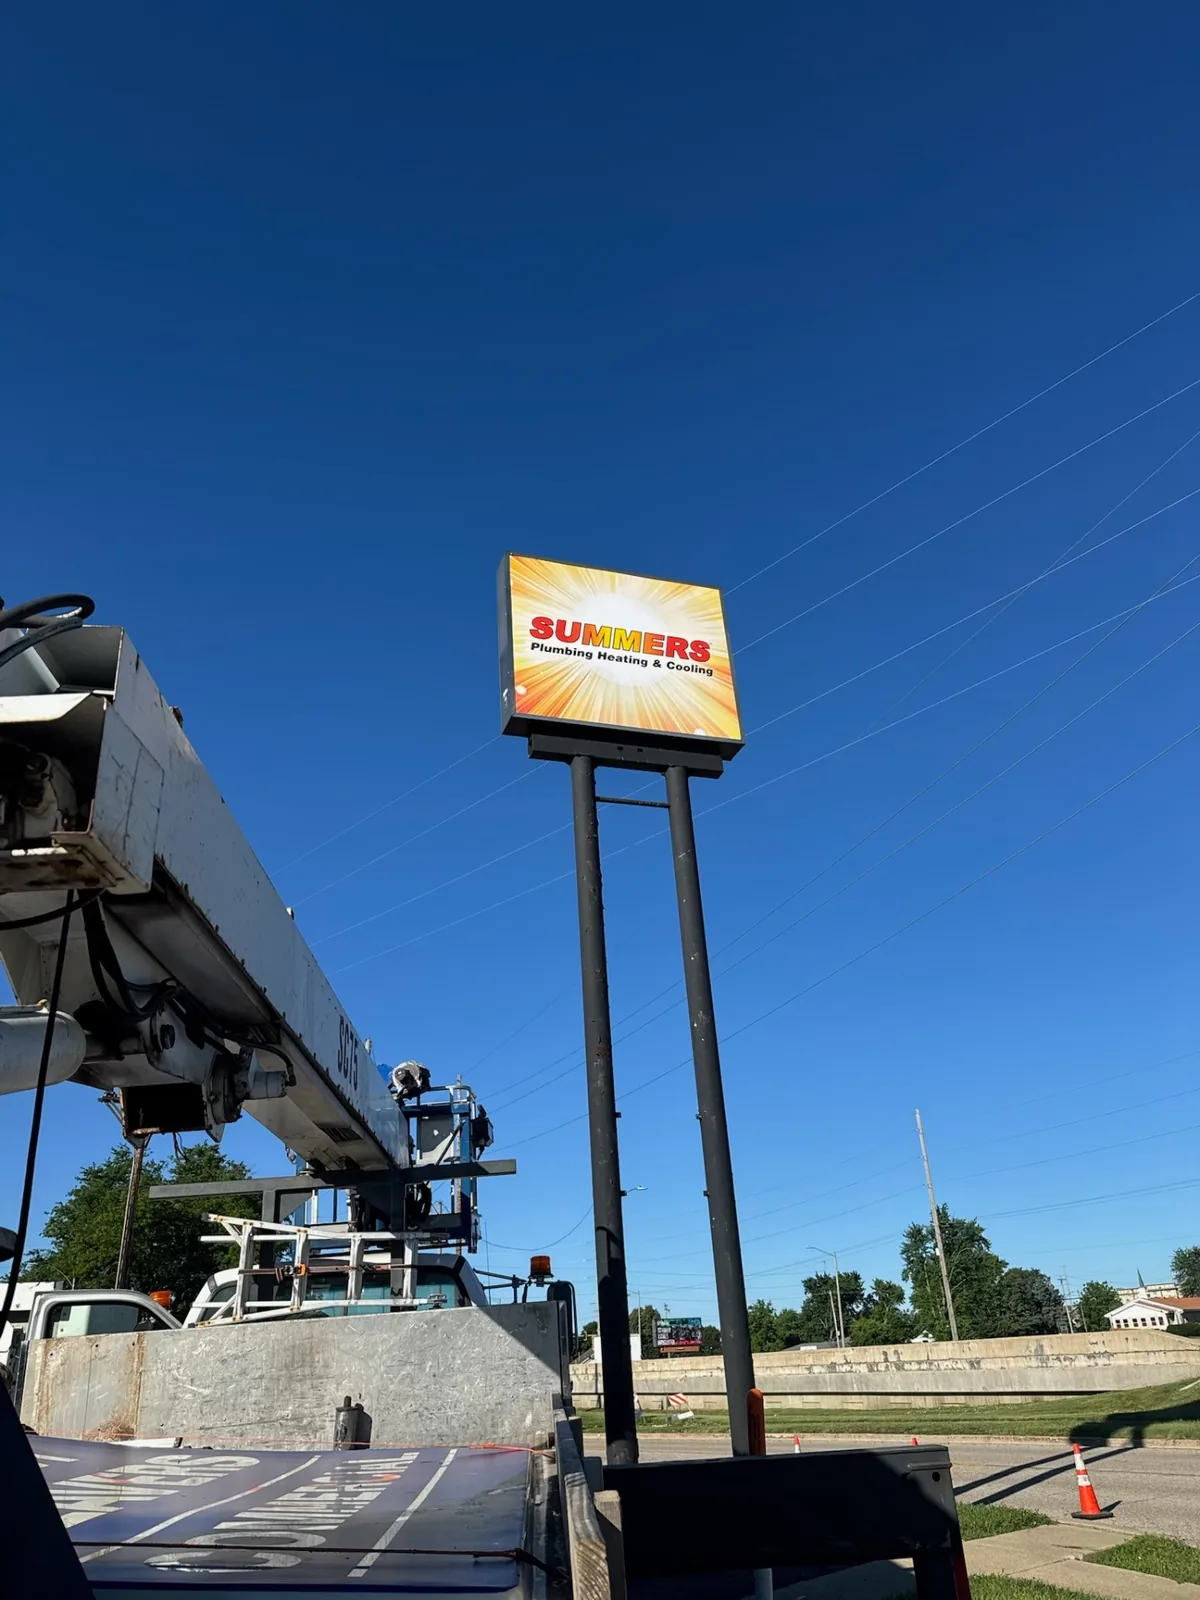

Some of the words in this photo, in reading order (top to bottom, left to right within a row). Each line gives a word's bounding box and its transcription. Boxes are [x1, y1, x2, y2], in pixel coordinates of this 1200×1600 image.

[529, 616, 711, 663] SUMMERS
[530, 642, 593, 660] Plumbing
[597, 651, 648, 667] Heating
[652, 659, 662, 668] &
[666, 661, 713, 677] Cooling
[337, 1014, 359, 1092] SC75
[50, 1453, 261, 1529] AVERS
[143, 1451, 420, 1573] COMMERCIAL
